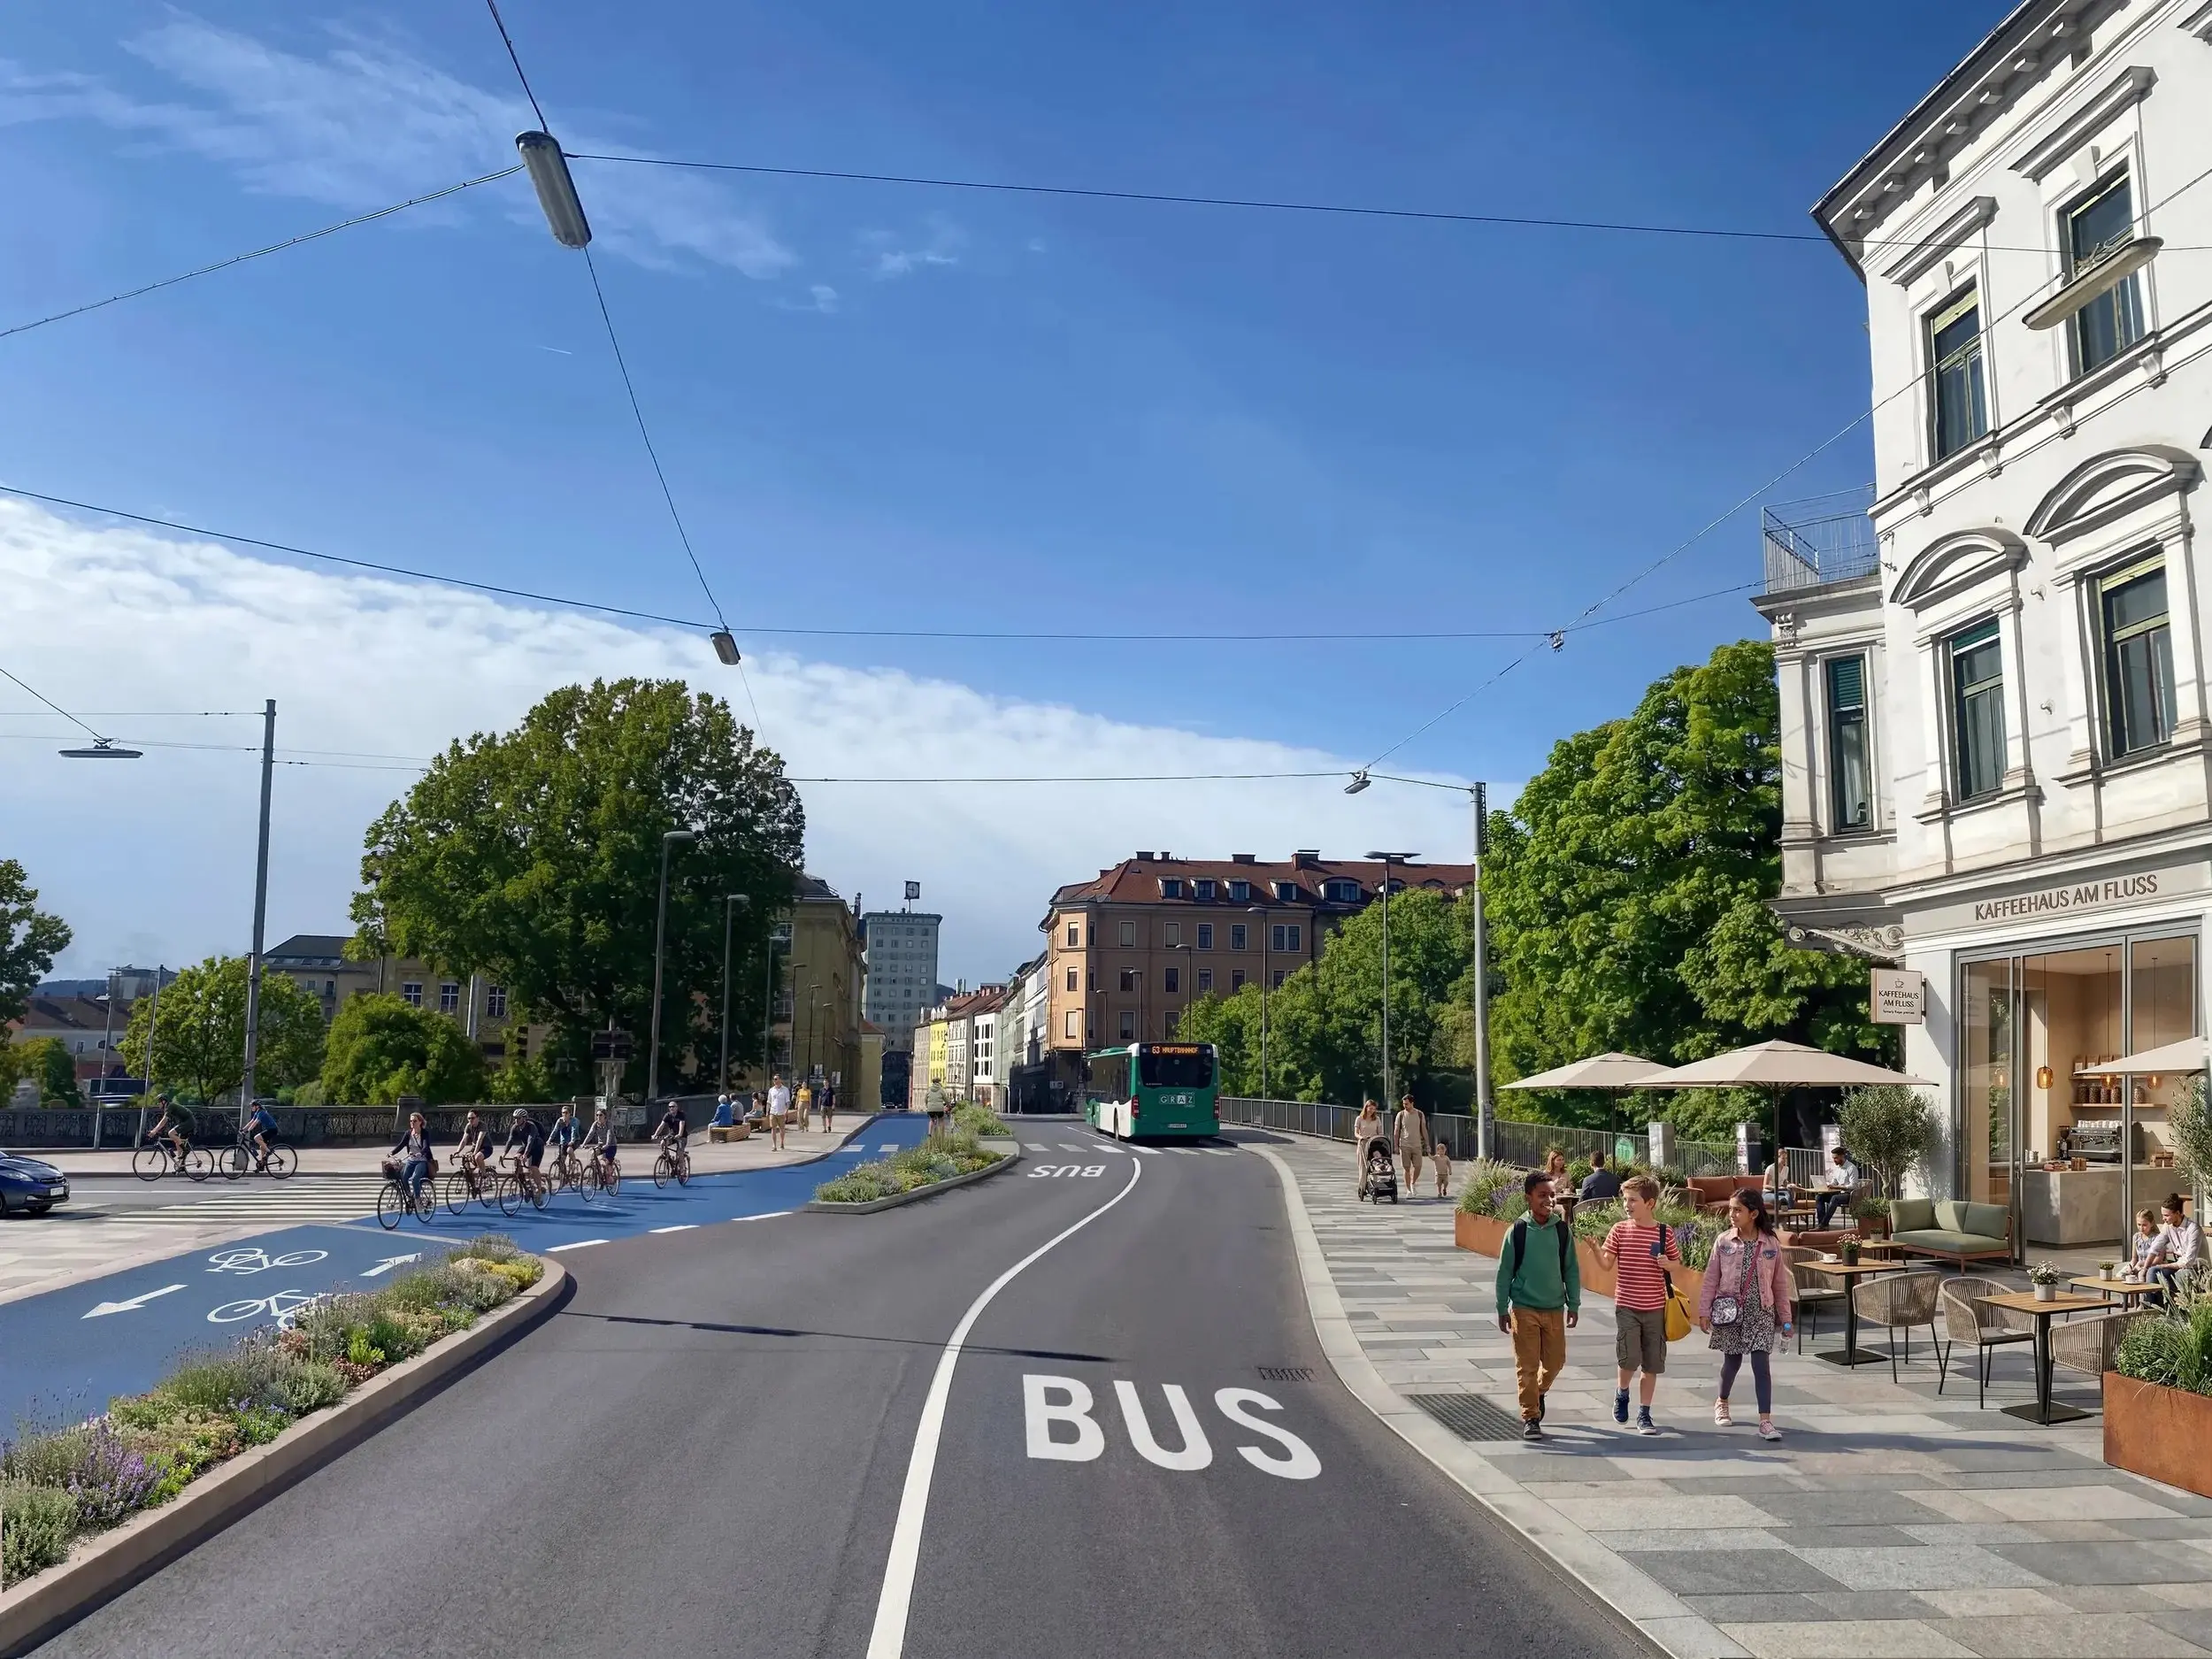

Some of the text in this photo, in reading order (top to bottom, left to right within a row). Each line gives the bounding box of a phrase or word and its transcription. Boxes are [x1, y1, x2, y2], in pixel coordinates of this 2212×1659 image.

[1975, 874, 2158, 921] KAFFEEHAUS AM FLUSS
[1878, 990, 1919, 1000] KAFFEEHAUS
[1026, 1164, 1107, 1178] BUS
[1022, 1373, 1323, 1480] BUS
